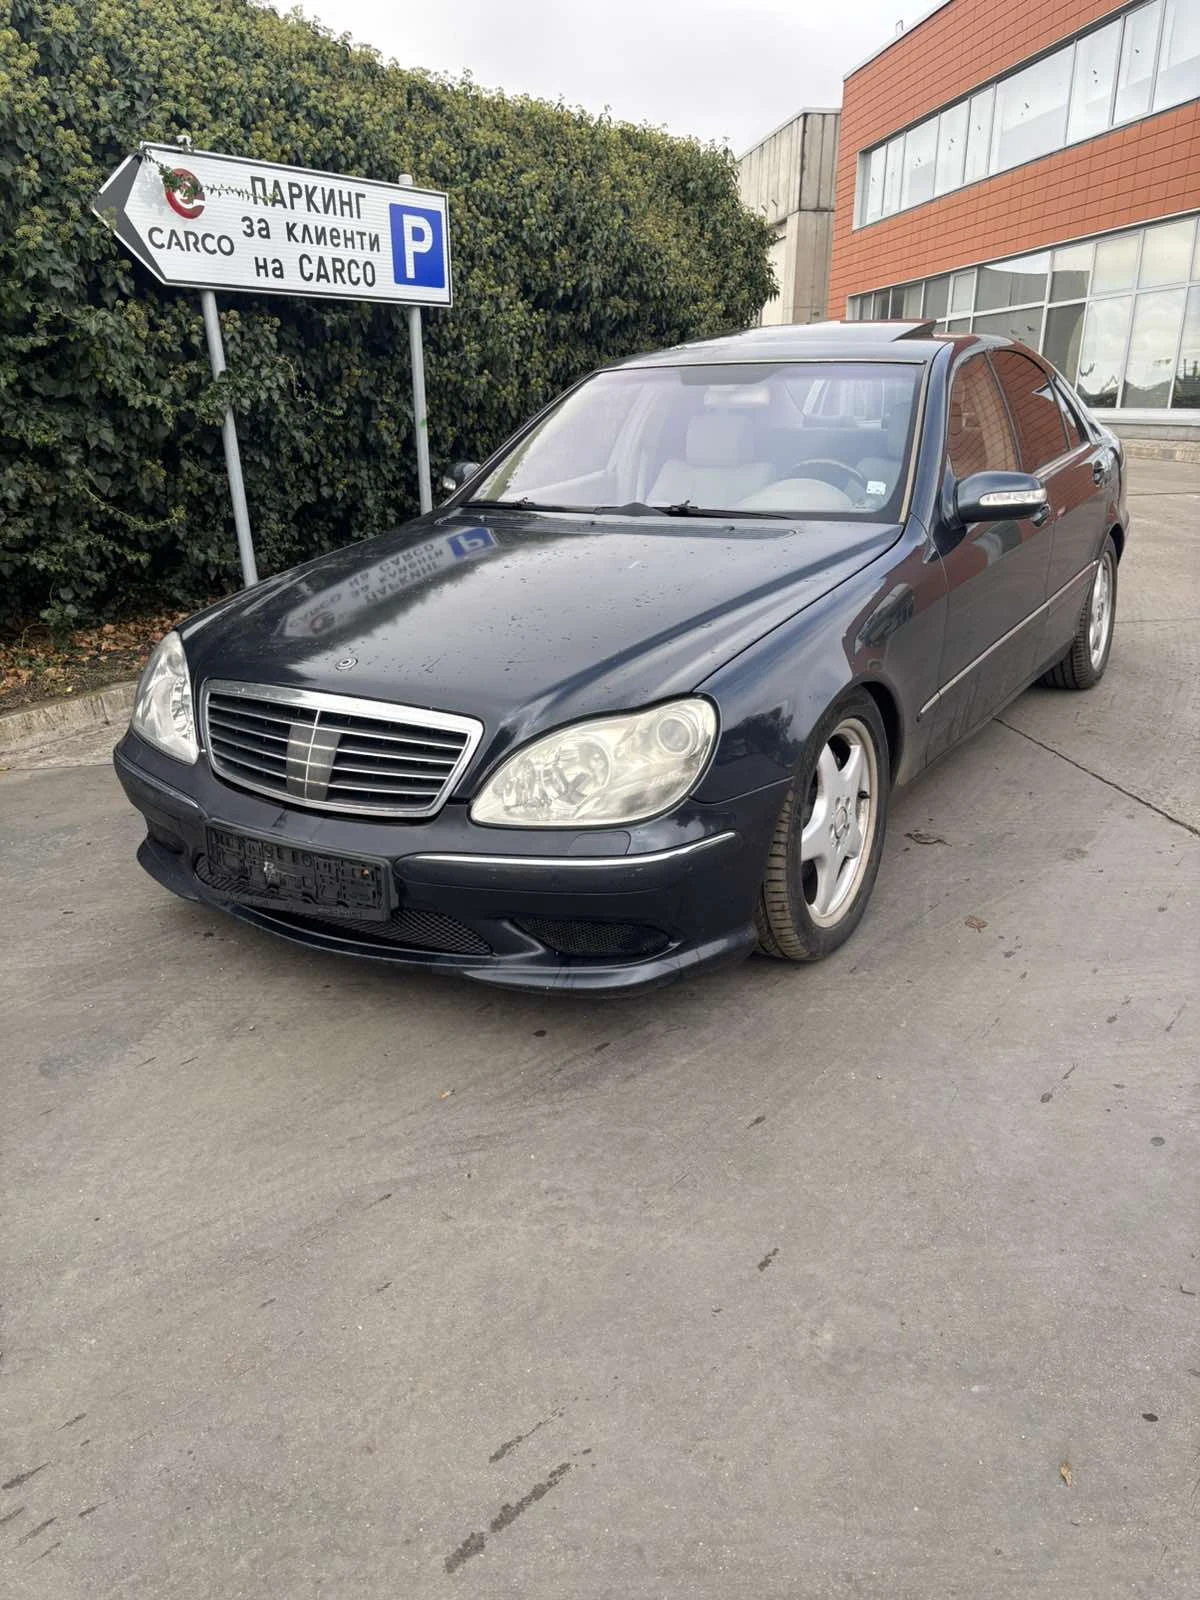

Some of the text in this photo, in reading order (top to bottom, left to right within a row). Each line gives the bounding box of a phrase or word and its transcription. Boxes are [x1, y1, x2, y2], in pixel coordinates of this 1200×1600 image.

[250, 175, 366, 219] ПАРКИНГ
[147, 226, 235, 257] CARCO
[240, 216, 380, 252] за клиенти
[402, 213, 433, 279] P
[254, 253, 376, 287] на CARCO
